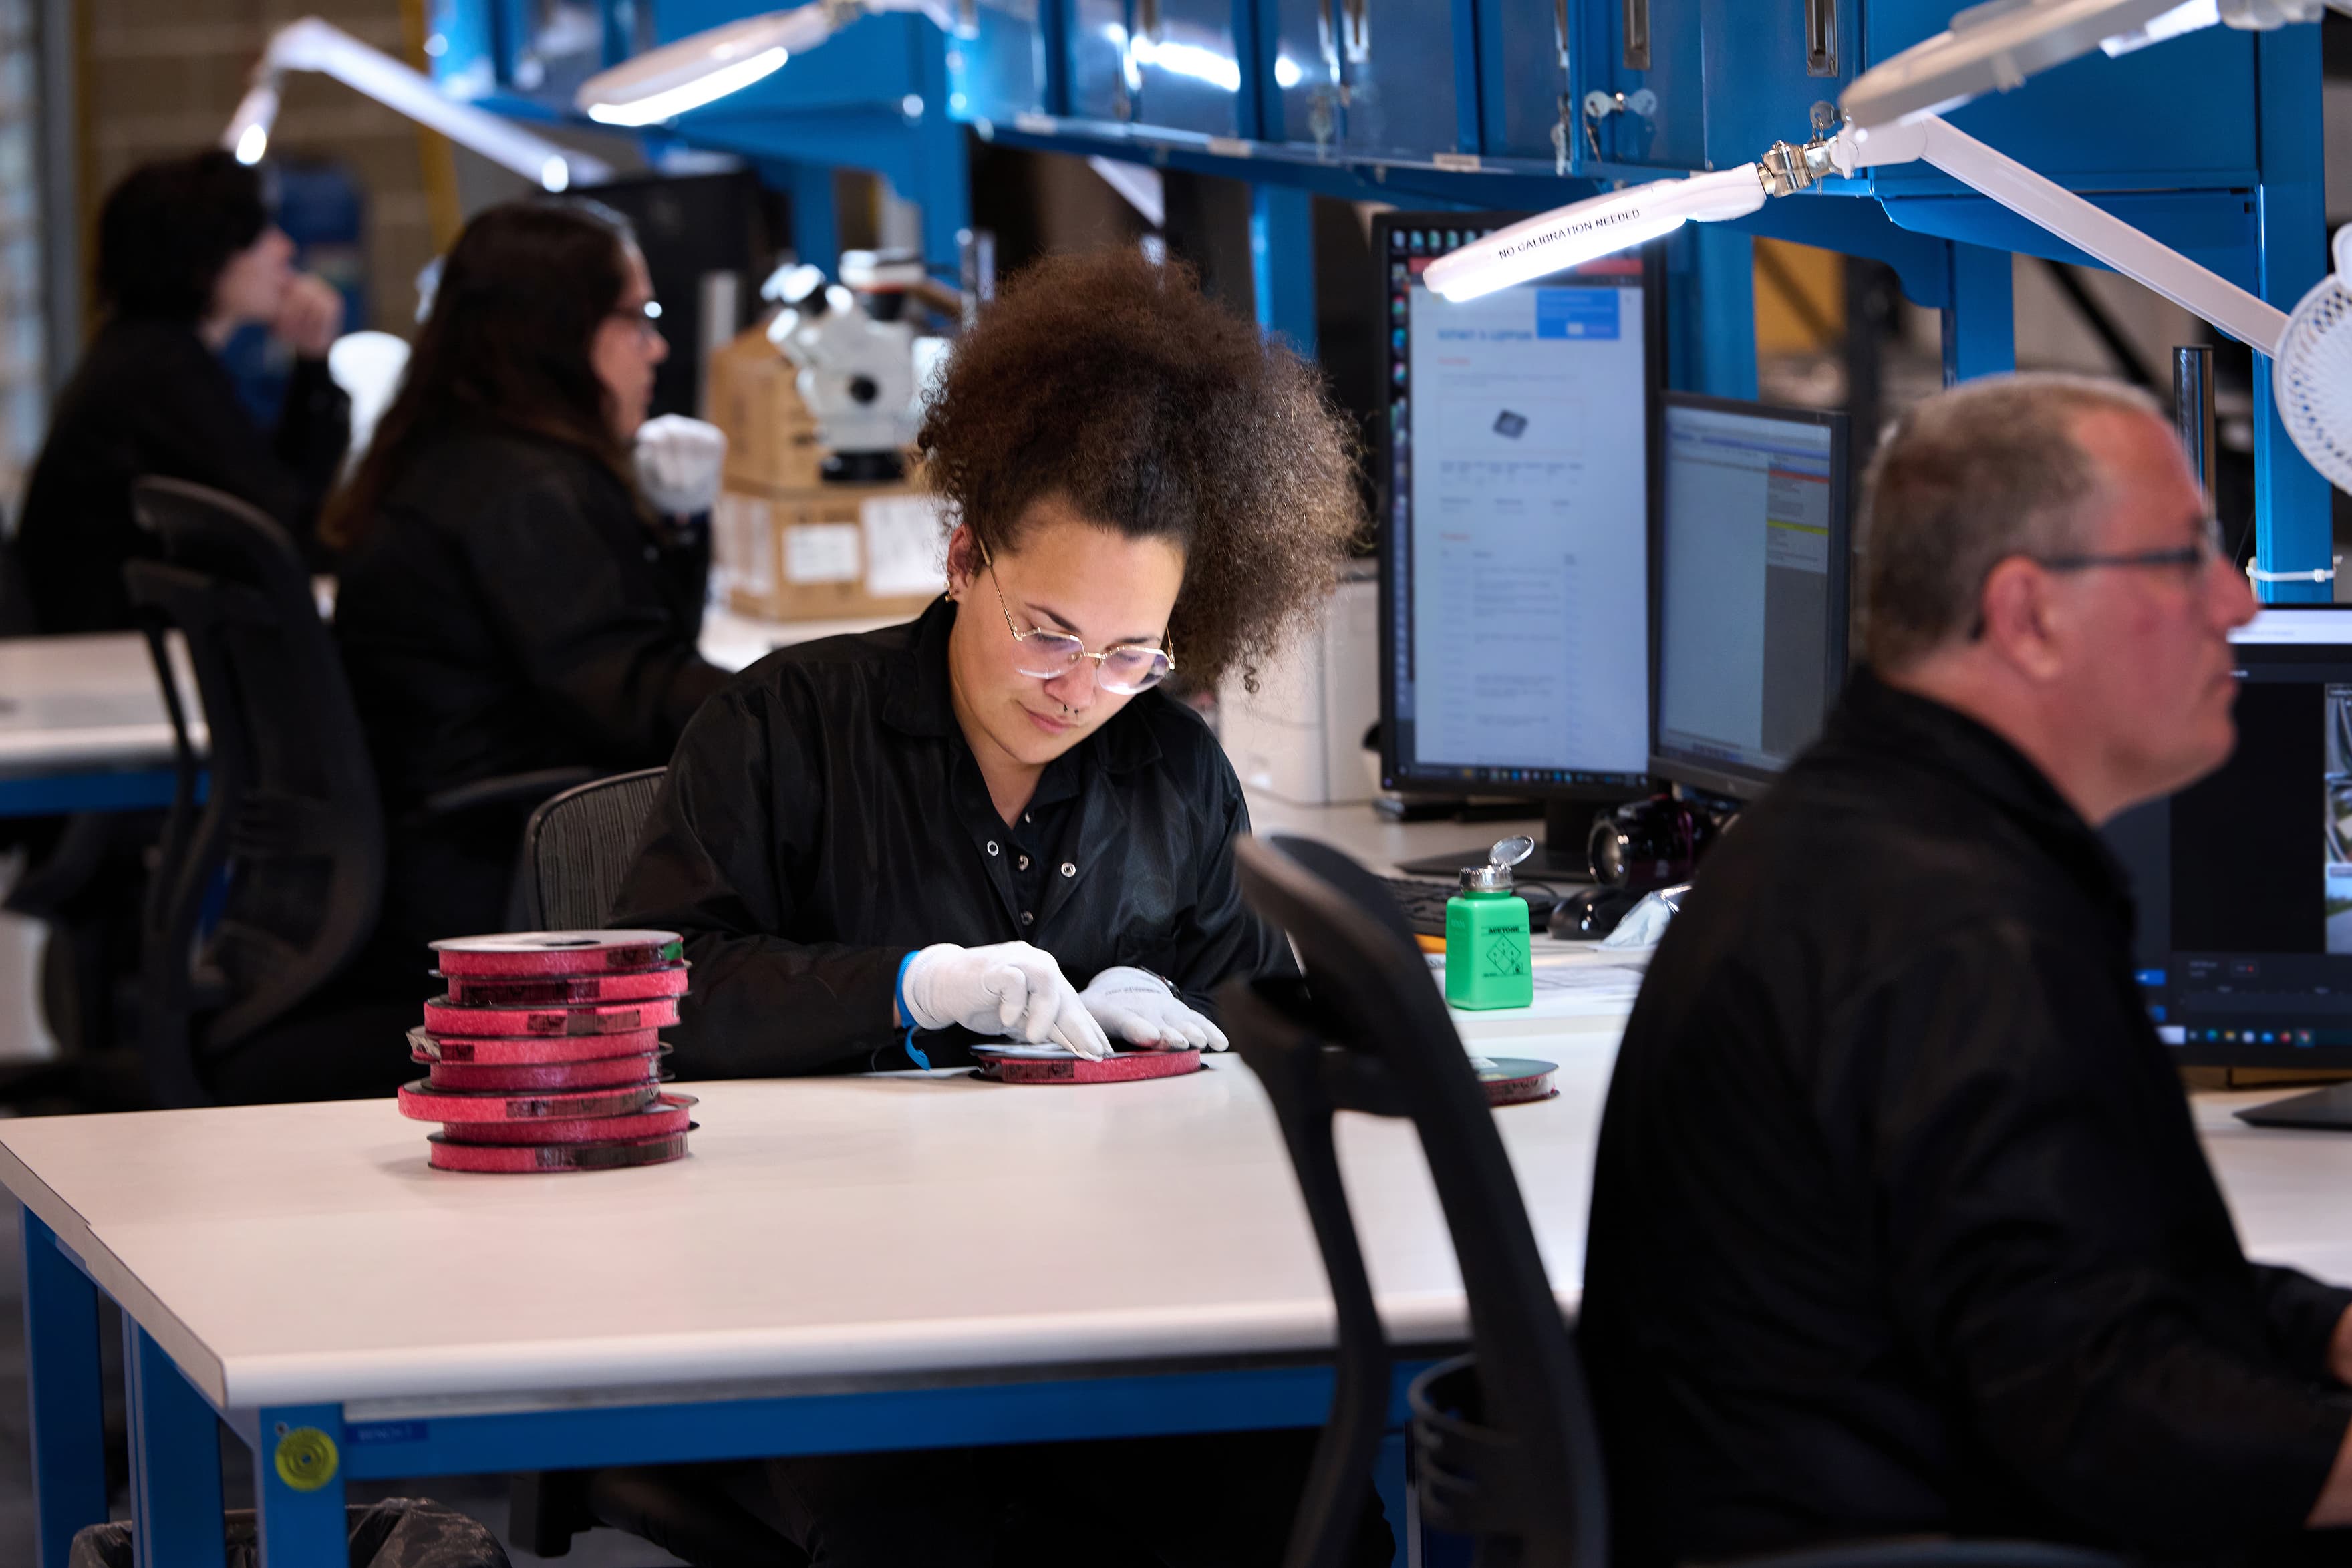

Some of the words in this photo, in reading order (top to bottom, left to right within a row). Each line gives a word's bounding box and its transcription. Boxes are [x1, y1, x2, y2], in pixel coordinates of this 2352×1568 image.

[1499, 245, 1515, 260] NO
[1517, 220, 1592, 252] CALIBRATION
[1596, 208, 1640, 228] NEEDED
[1488, 925, 1519, 935] ACETONE
